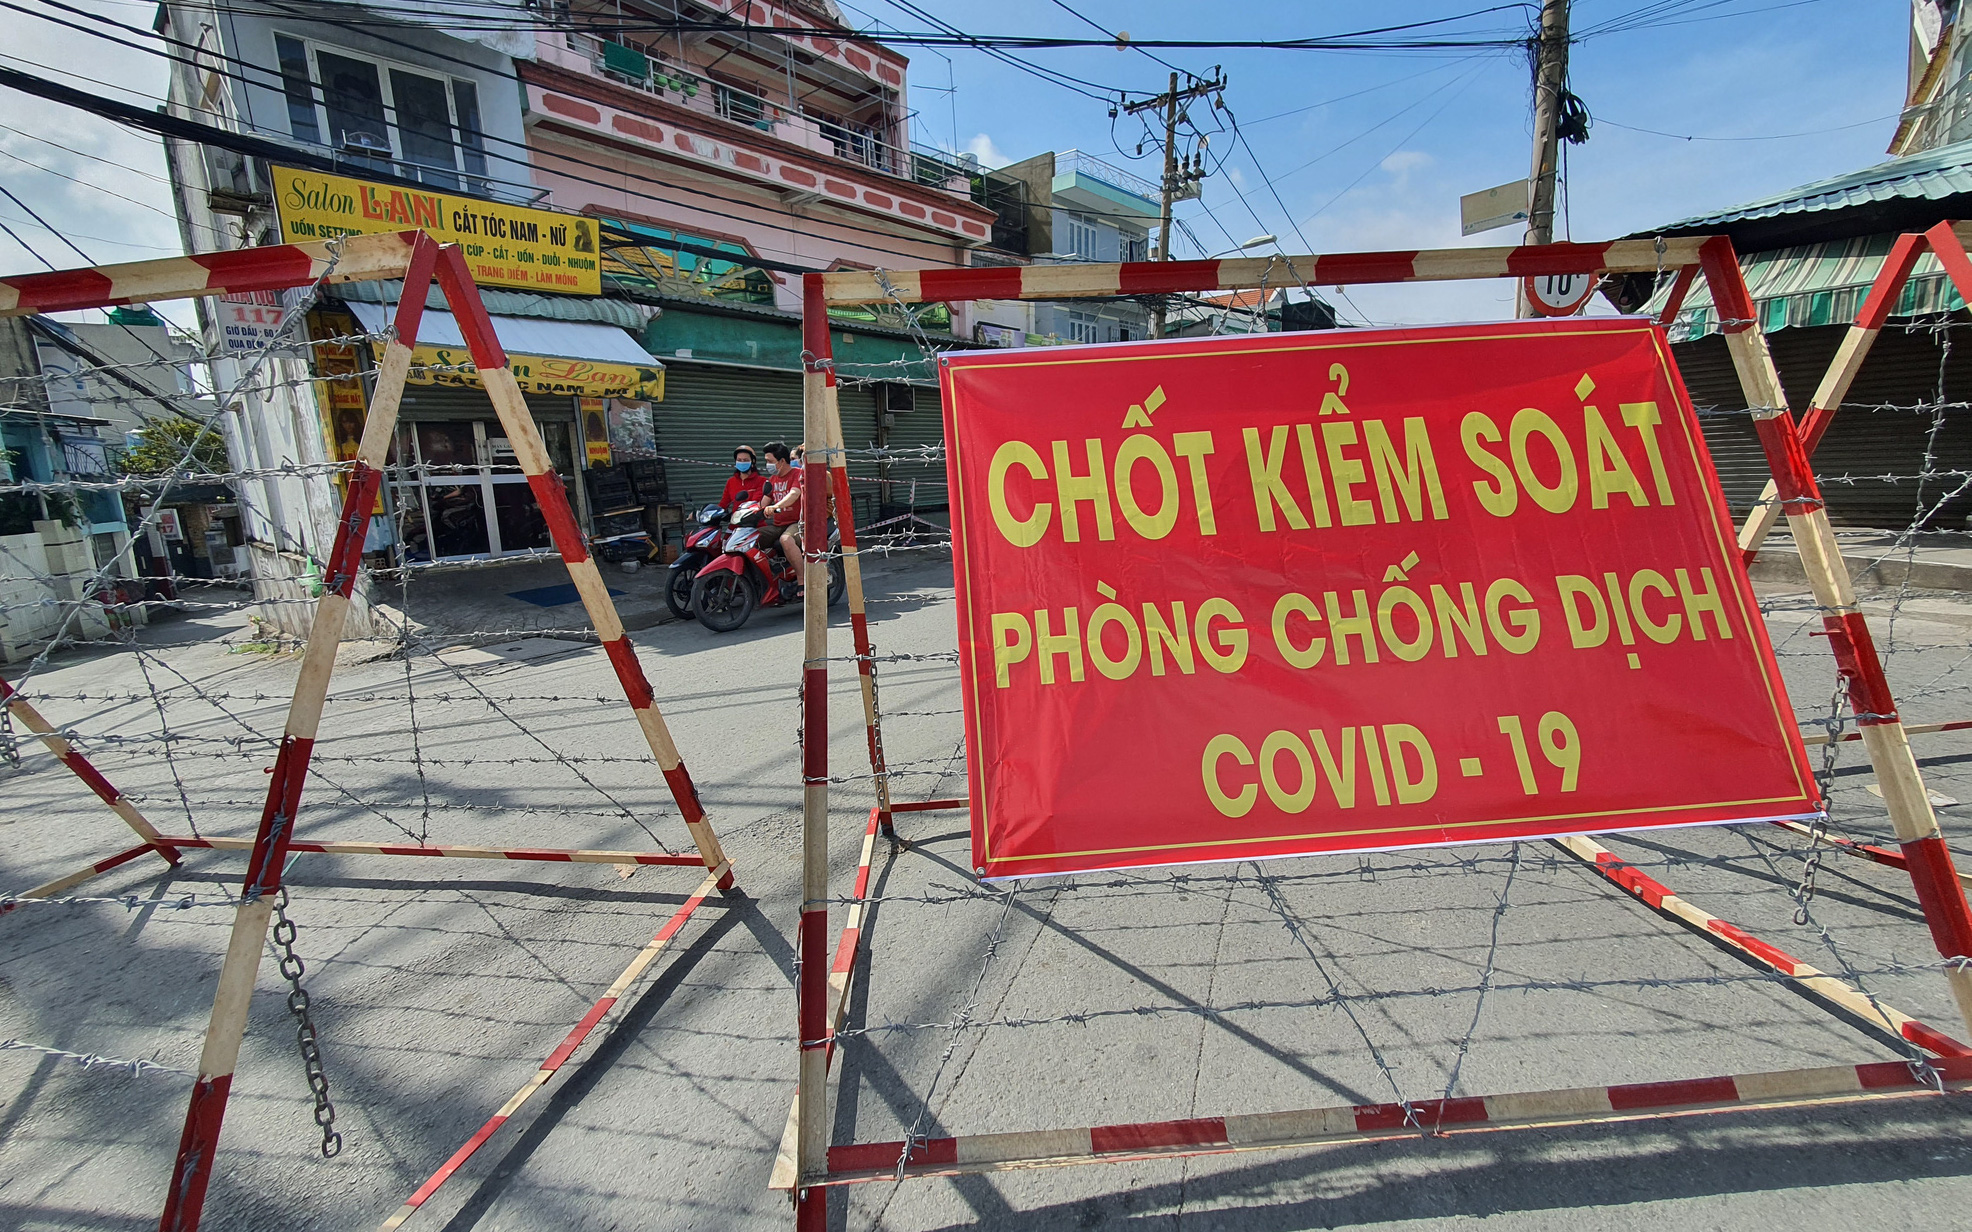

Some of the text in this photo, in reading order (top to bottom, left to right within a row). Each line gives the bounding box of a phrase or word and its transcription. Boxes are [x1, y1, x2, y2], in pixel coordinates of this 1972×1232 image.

[284, 178, 443, 229] Salon LAN
[290, 217, 316, 237] UỐN
[453, 204, 477, 235] CẮT
[481, 212, 506, 239] TÓC
[510, 220, 538, 243] NAM
[550, 224, 567, 247] NỮ
[467, 243, 484, 257] CÚP
[517, 248, 534, 264] UỐN
[567, 256, 596, 273] NHUỘM
[476, 264, 504, 279] TRANG
[536, 269, 553, 284] LÀM
[555, 272, 578, 286] MÓNG
[231, 307, 284, 325] 117
[226, 323, 240, 336] GIỜ
[228, 339, 245, 349] QUA
[540, 360, 628, 385] Lan
[537, 382, 584, 393] NAM
[988, 363, 1675, 548] CHỐT KIỂM SOÁT
[991, 551, 1733, 689] PHÒNG CHỐNG DỊCH
[1202, 725, 1438, 818] COVID
[1498, 711, 1581, 795] 19
